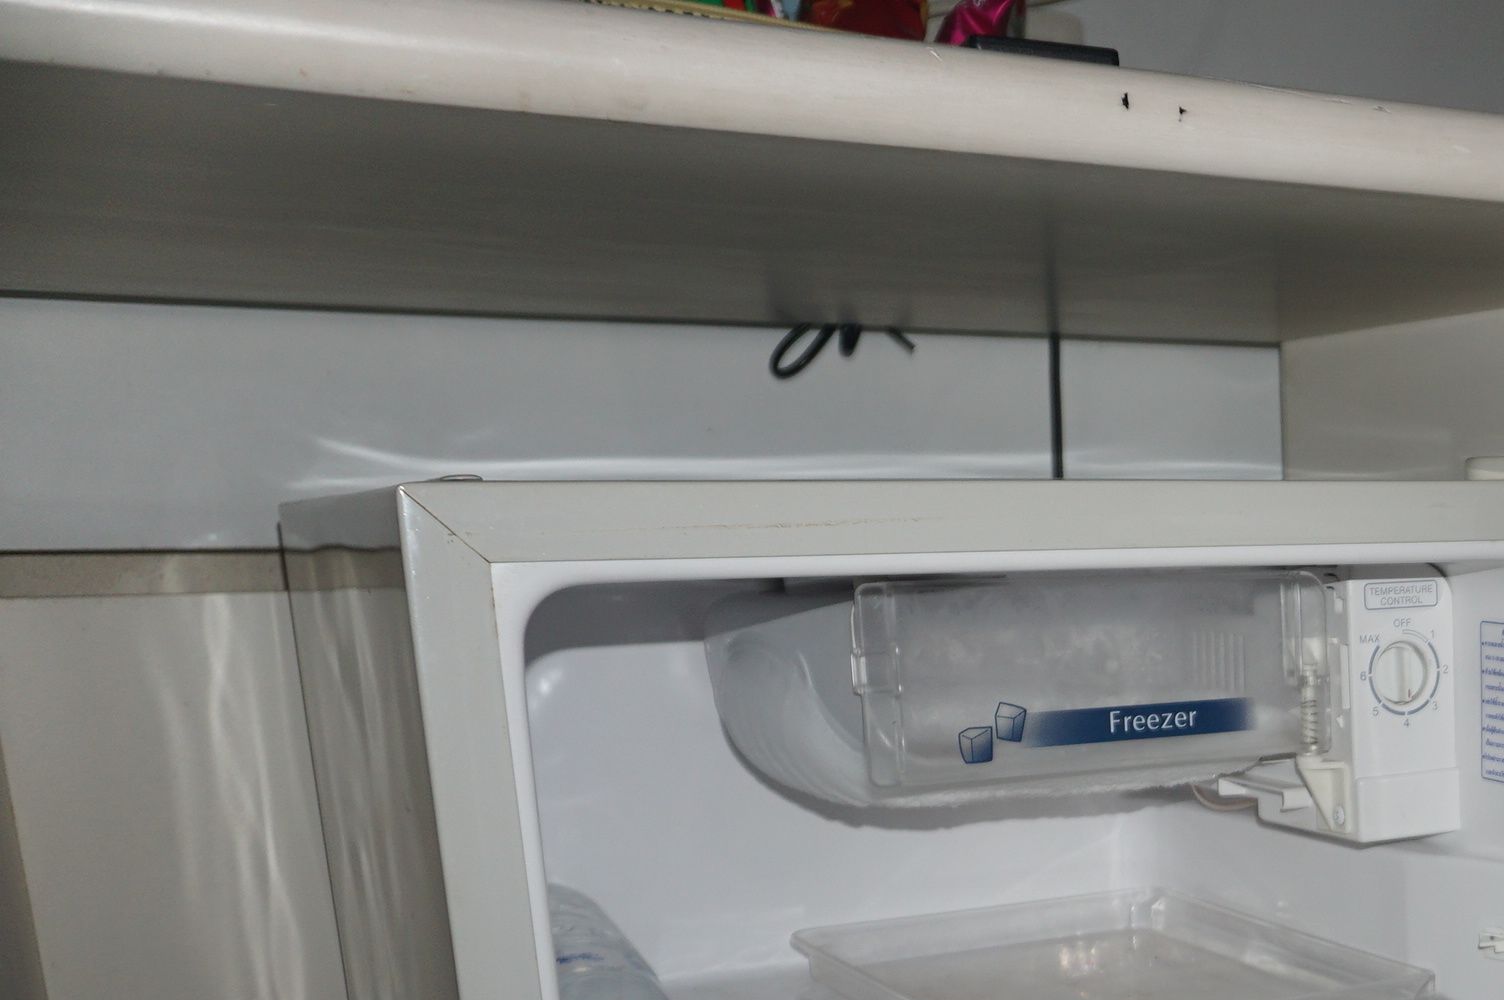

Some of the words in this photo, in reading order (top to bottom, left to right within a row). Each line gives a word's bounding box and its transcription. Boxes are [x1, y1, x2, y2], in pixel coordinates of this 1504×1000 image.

[1370, 584, 1433, 596] TEMPERATURE
[1380, 596, 1423, 606] CONTROL
[1393, 618, 1412, 628] OFF
[1359, 634, 1380, 643] MAX
[1443, 665, 1448, 674] 2
[1360, 671, 1367, 681] 6
[1433, 701, 1438, 710] 3
[1372, 707, 1379, 716] 5
[1109, 710, 1197, 734] Freezer
[1403, 718, 1410, 727] 4
